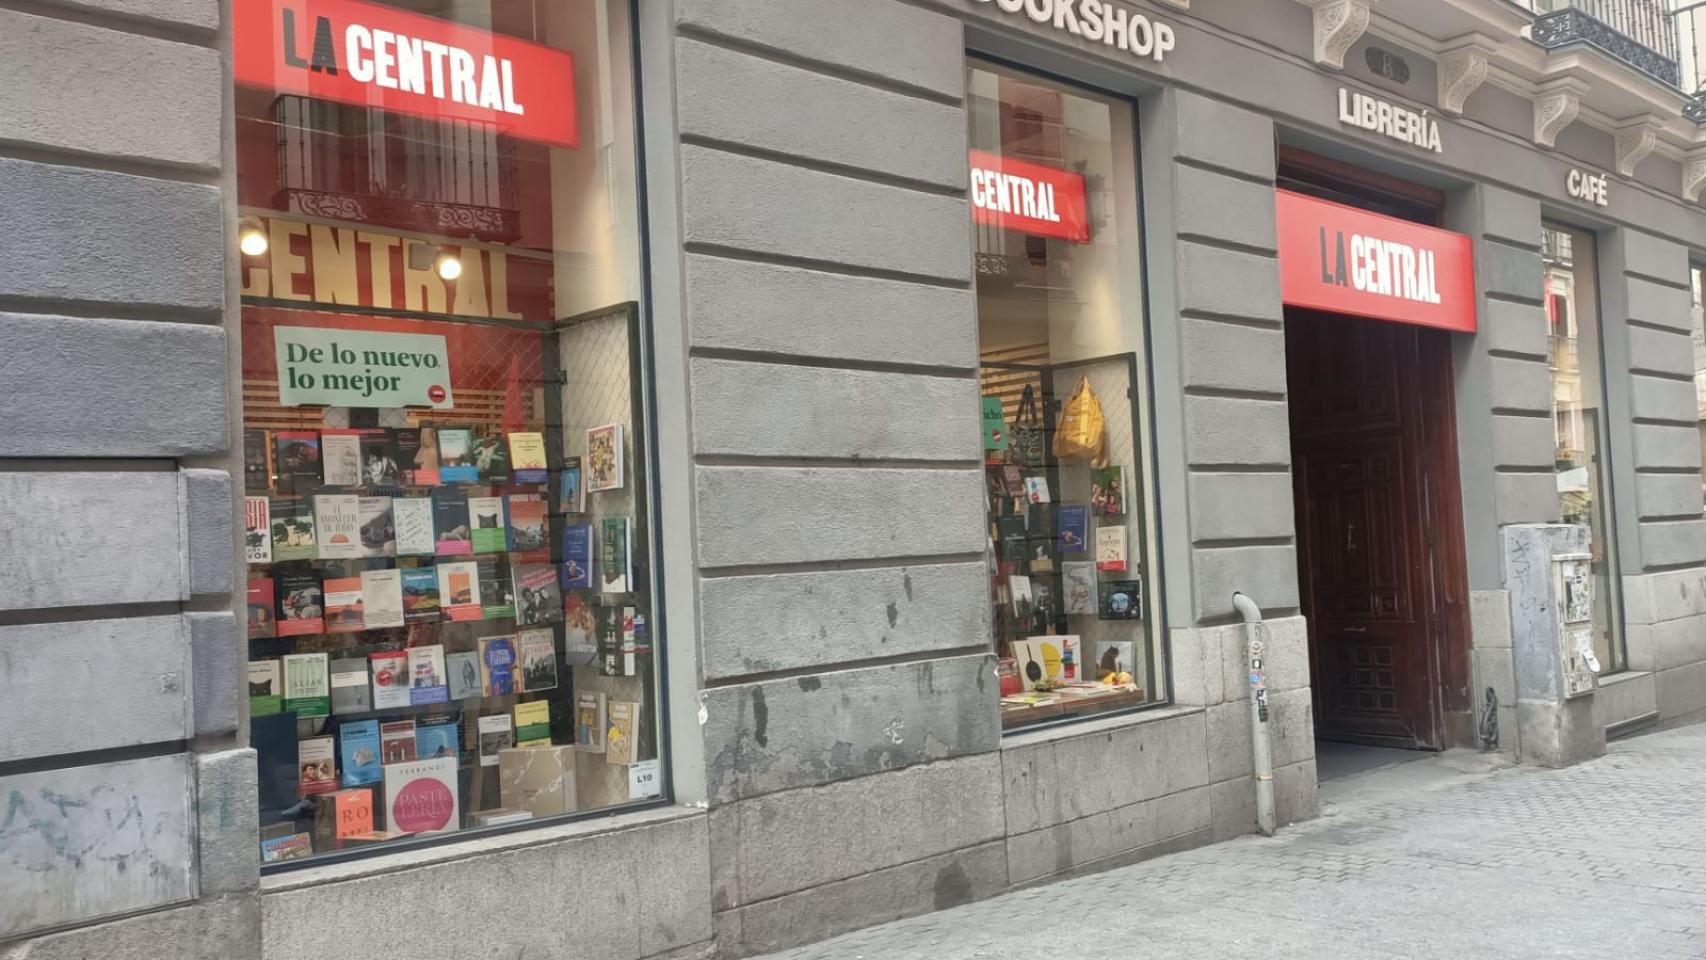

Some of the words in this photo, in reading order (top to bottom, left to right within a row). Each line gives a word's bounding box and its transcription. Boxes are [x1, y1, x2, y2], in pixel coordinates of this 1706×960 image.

[282, 7, 338, 77] LA
[345, 23, 524, 115] CENTRAL
[1337, 87, 1443, 153] LIBRERÍA
[970, 167, 1061, 222] CENTRAL
[1566, 168, 1609, 206] CAFÉ
[1319, 226, 1348, 288] LA
[1350, 233, 1441, 304] CENTRAL
[285, 342, 324, 364] De
[331, 343, 356, 365] lo
[288, 367, 315, 389] lo
[322, 368, 401, 398] mejor
